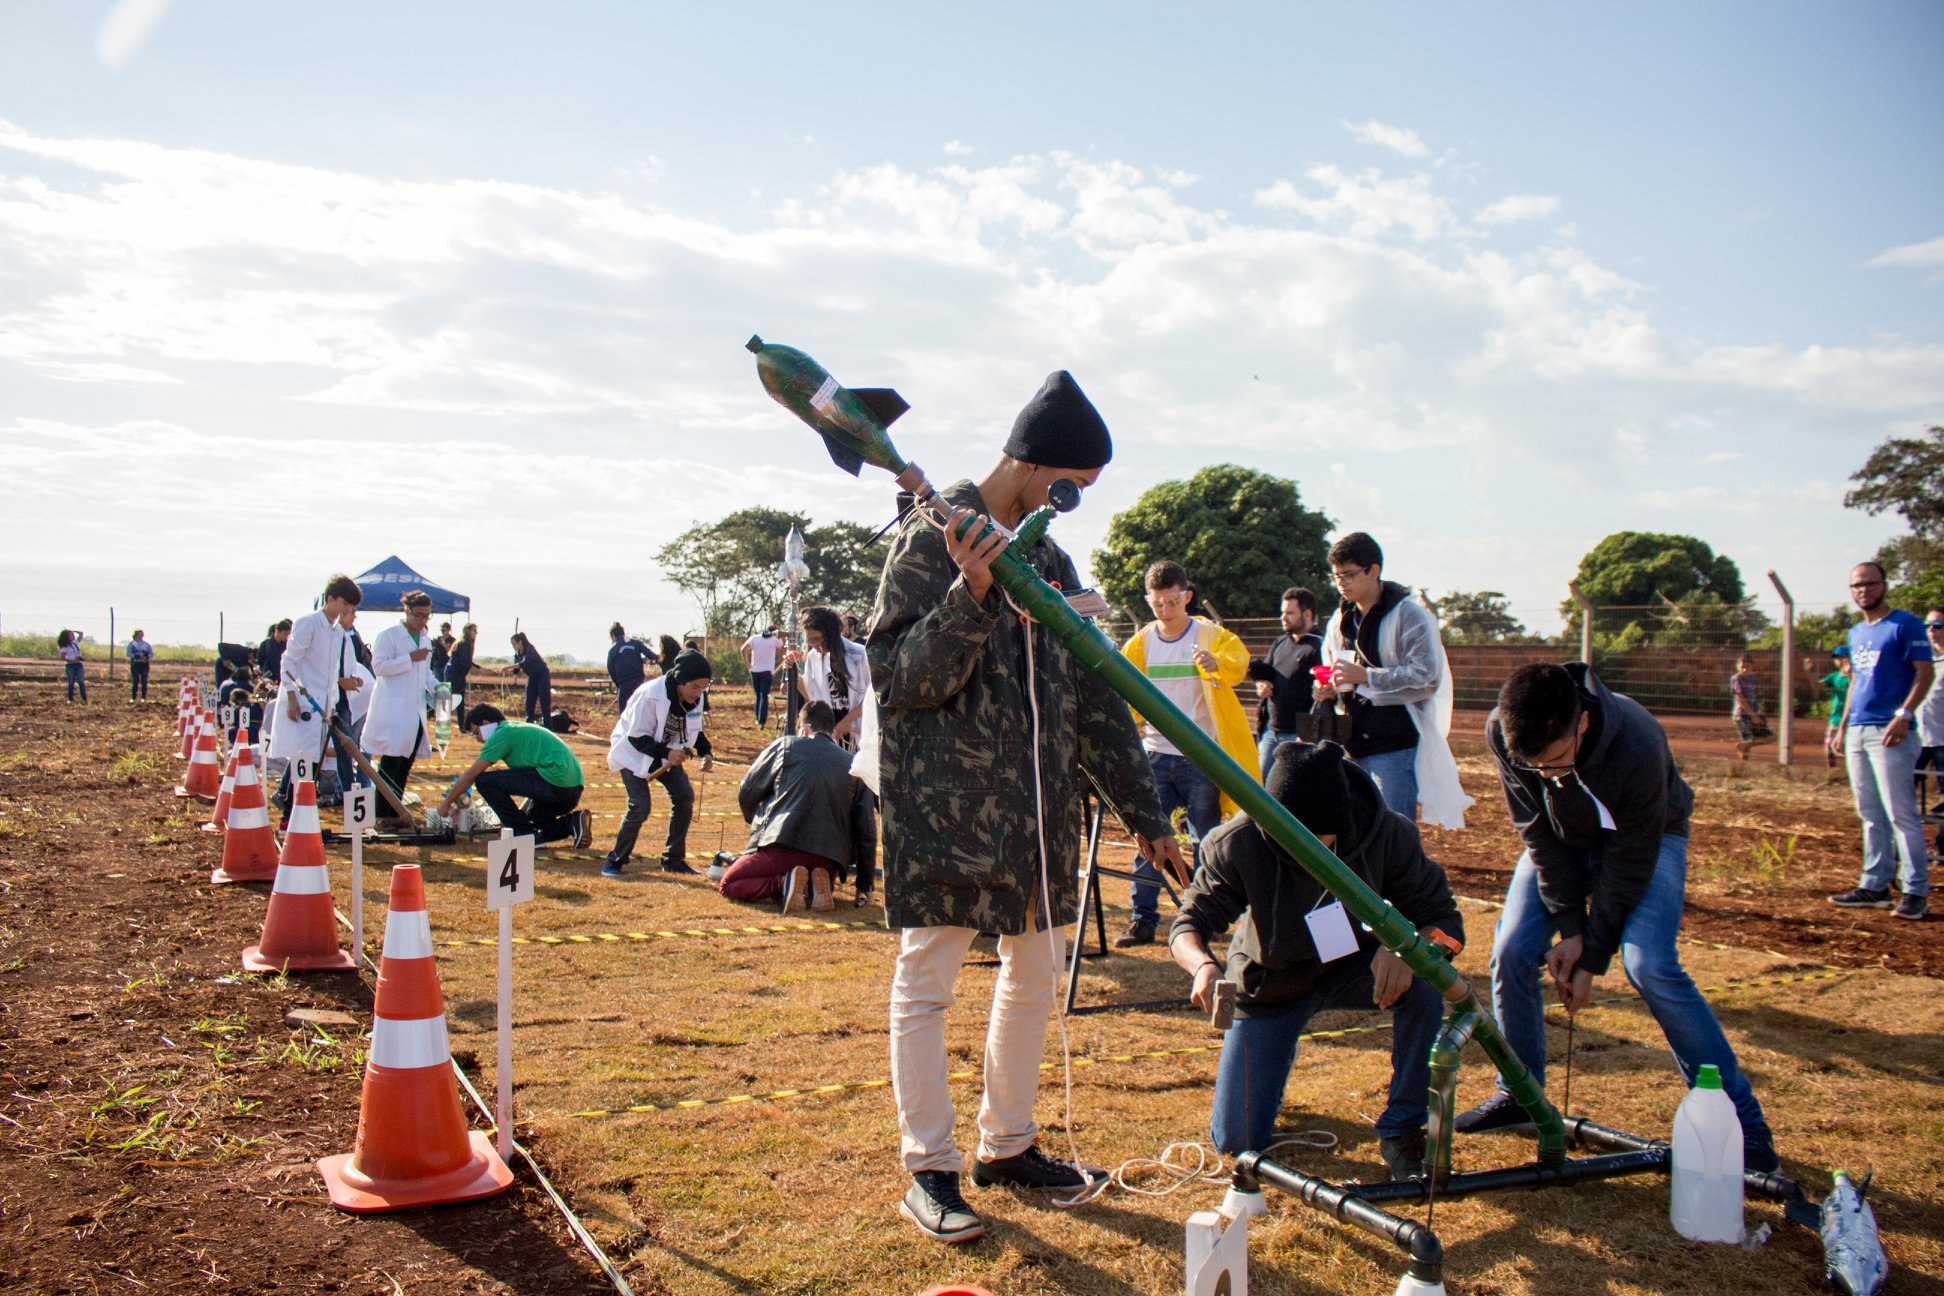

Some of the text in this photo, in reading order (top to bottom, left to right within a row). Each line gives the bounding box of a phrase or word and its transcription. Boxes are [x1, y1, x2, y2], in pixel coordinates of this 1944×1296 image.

[207, 698, 216, 708] 10
[225, 710, 231, 721] 9
[242, 711, 247, 724] 8
[264, 738, 271, 752] 7
[297, 759, 306, 778] 6
[353, 795, 366, 823] 5
[499, 847, 520, 893] 4
